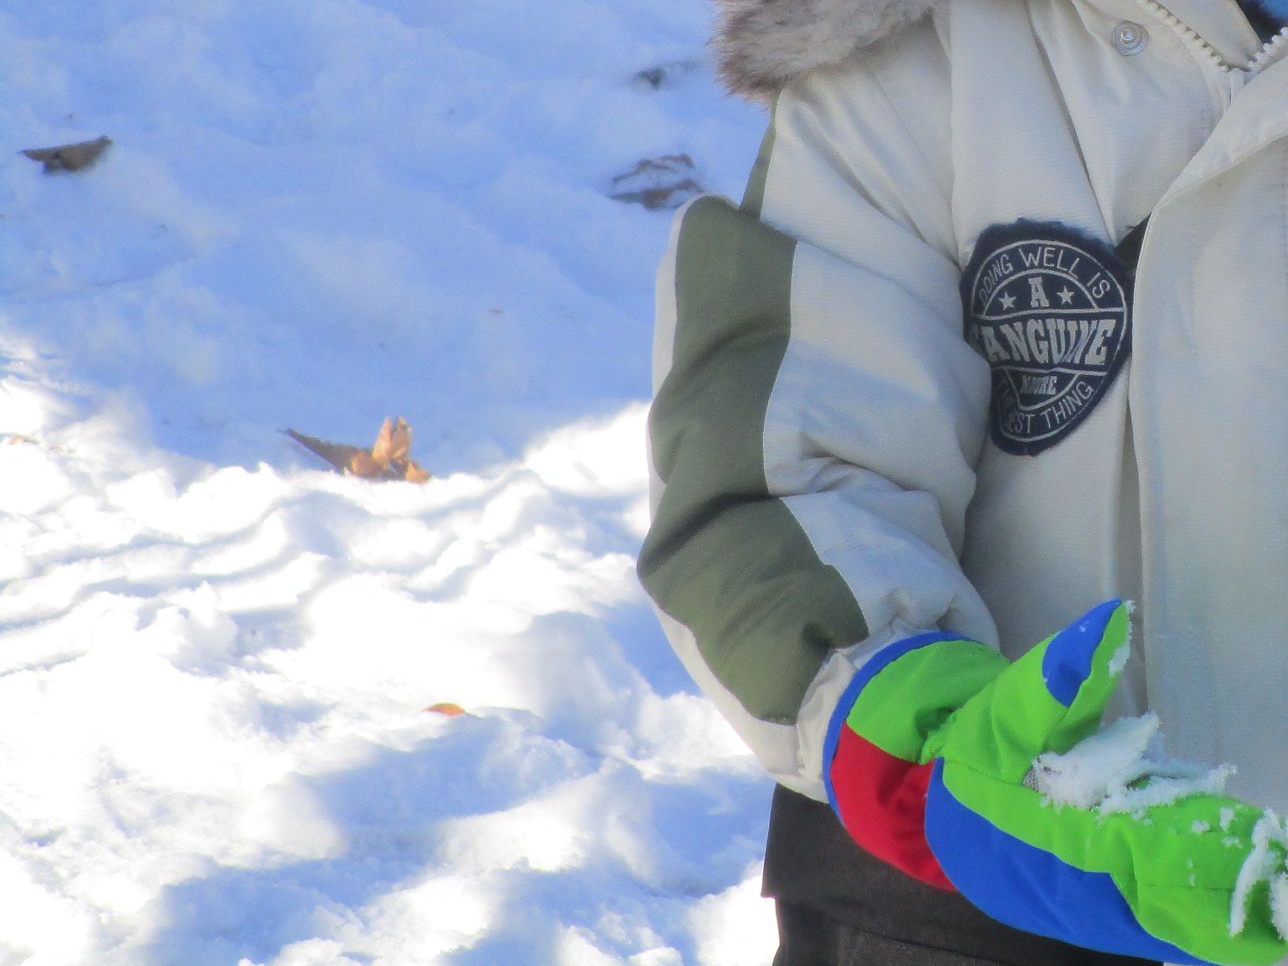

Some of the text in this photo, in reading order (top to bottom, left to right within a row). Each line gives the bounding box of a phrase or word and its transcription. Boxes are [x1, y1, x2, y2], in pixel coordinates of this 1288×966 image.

[979, 247, 1111, 307] DOING WELL IS
[1028, 276, 1050, 307] A
[973, 318, 1116, 366] ANGUINE
[1040, 380, 1095, 430] THING
